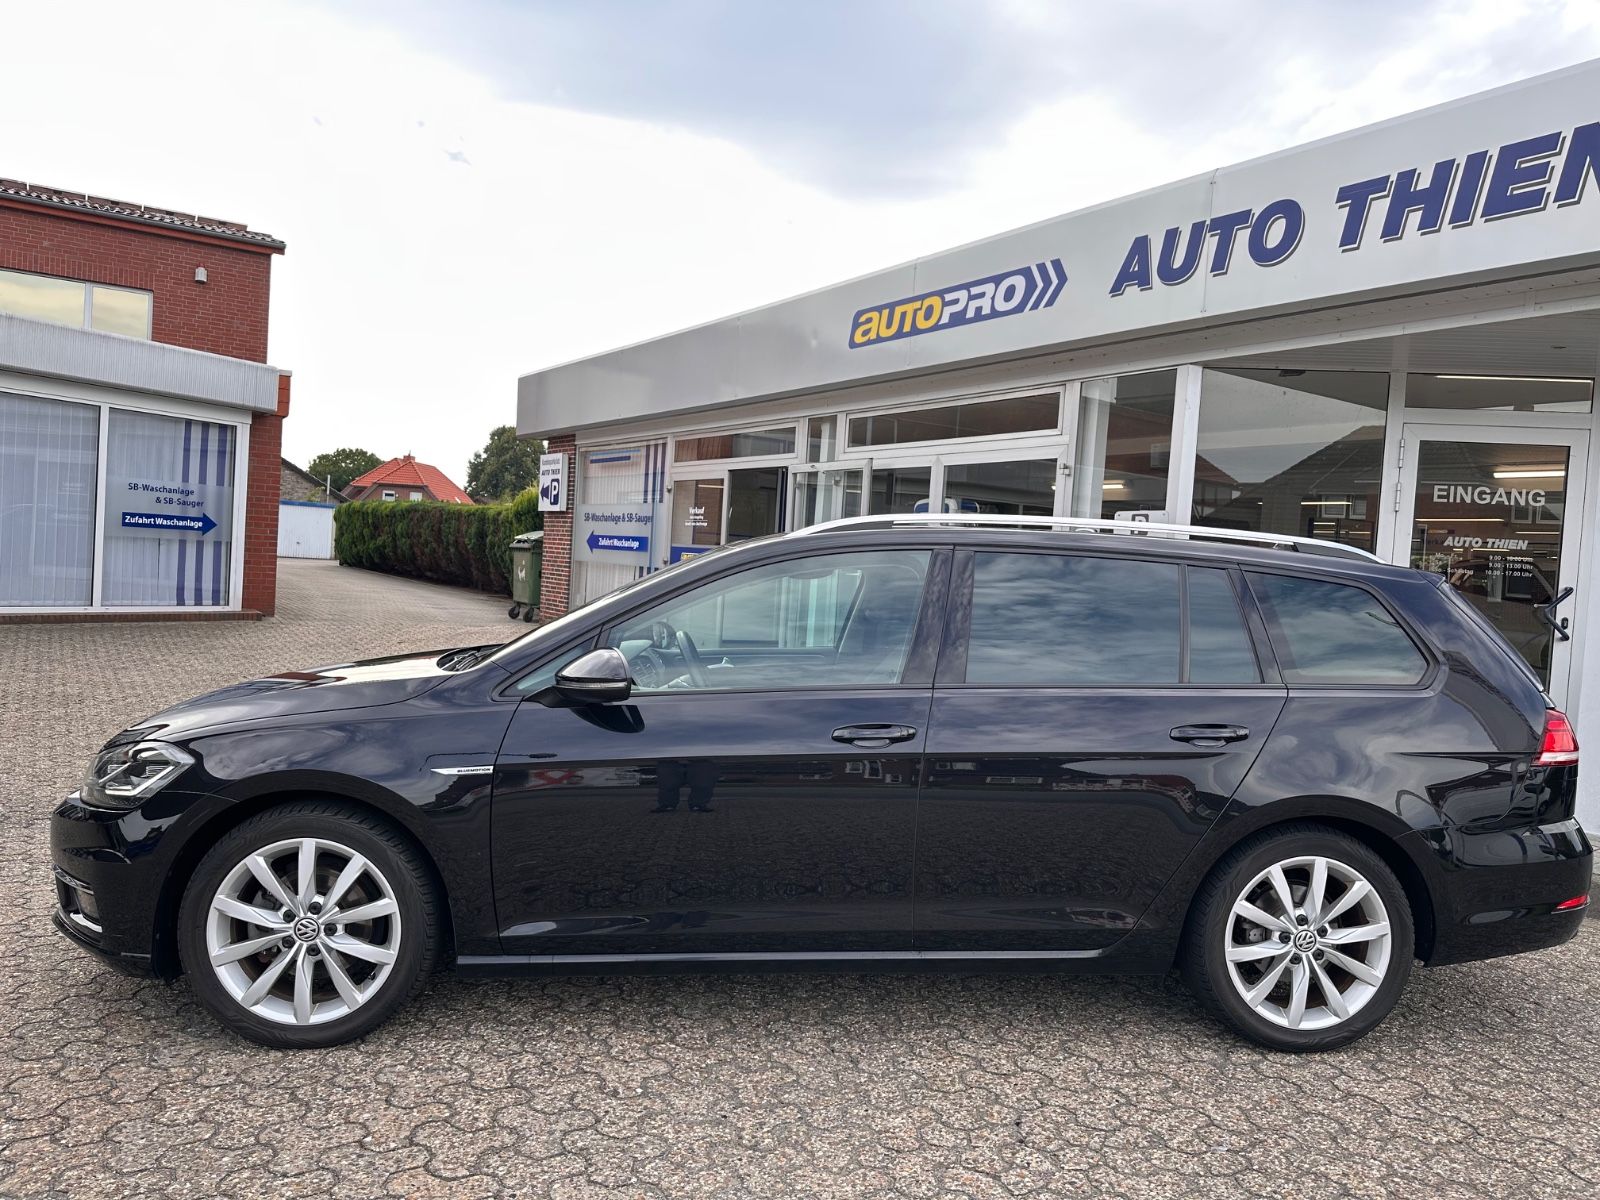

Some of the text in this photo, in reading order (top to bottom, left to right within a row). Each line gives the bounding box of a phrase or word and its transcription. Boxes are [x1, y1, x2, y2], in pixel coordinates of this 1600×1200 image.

[1109, 198, 1304, 298] AUTO
[128, 482, 195, 497] SB-Waschanlage
[1433, 484, 1546, 507] EINGANG
[155, 496, 205, 508] & SB-Sauger
[125, 515, 203, 529] Zufahrt Waschanlage
[584, 512, 654, 526] SB-Waschanlage & SB-Sauger
[598, 537, 640, 550] Zufahrt Waschanlage
[1443, 536, 1483, 548] AUTO
[1485, 538, 1529, 550] THIEN
